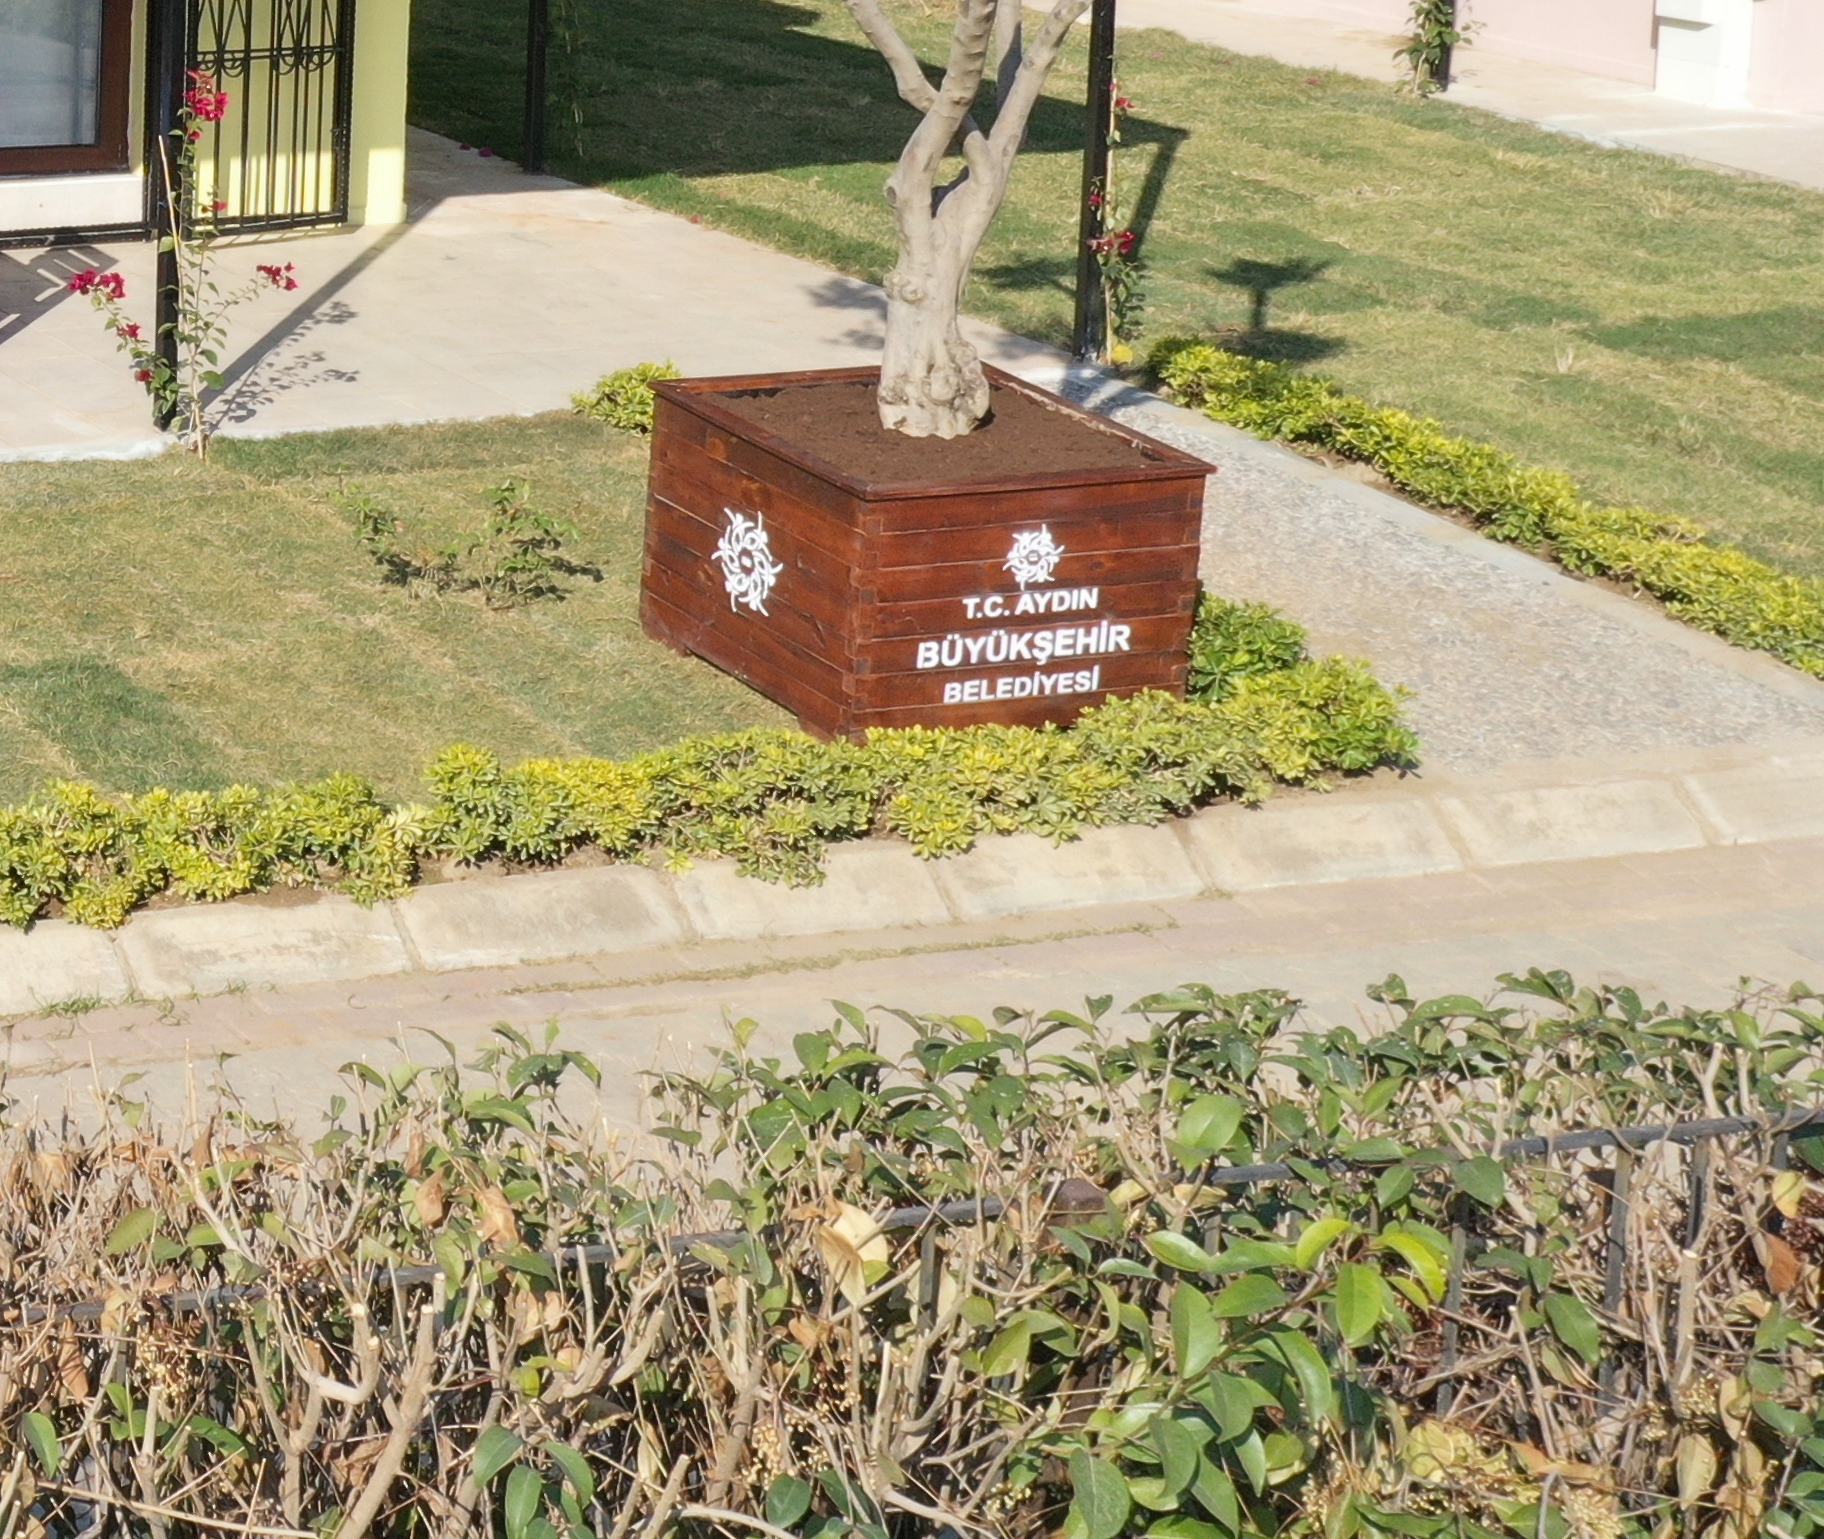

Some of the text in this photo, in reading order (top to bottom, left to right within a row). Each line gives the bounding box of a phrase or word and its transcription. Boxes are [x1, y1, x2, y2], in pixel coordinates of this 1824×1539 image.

[962, 586, 1099, 620] T.C. AYDIN
[916, 619, 1131, 671] BÜYÜKŞEHİR
[942, 663, 1100, 704] BELEDİYESİ
